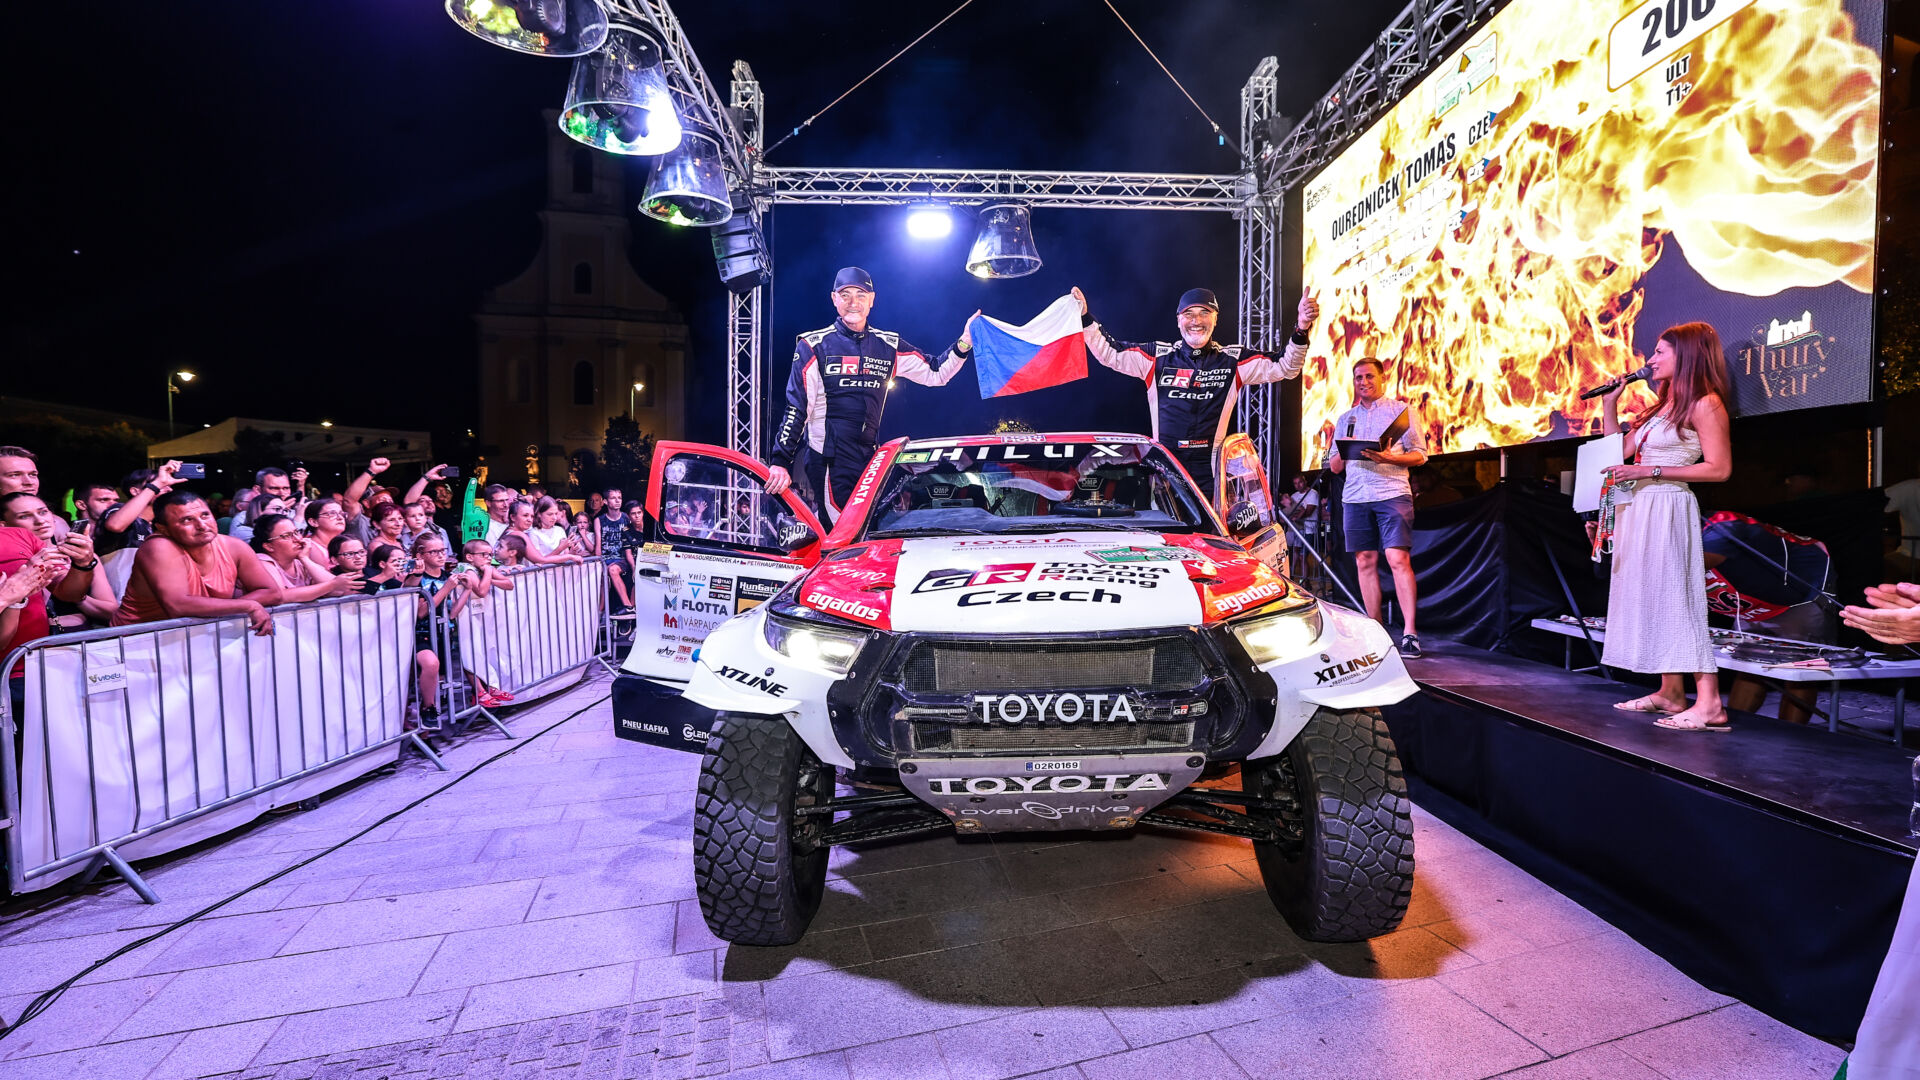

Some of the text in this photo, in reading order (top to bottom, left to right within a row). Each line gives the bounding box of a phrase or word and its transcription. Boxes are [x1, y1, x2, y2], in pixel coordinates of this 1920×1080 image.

[1666, 55, 1690, 83] ULT
[1666, 83, 1691, 106] T1+
[1332, 173, 1400, 241] OUREDNICEK
[1405, 132, 1456, 189] TOMAS
[1468, 115, 1489, 146] CZE
[825, 363, 859, 375] GR
[863, 356, 892, 366] TOYOTA
[862, 368, 888, 379] Racing
[1197, 368, 1231, 376] TOYOTA
[839, 378, 881, 389] Czech
[1160, 375, 1190, 388] GR
[1168, 389, 1214, 400] Czech
[779, 405, 797, 446] HILUX
[929, 444, 1124, 462] HILUX
[852, 450, 888, 506] MUSICDATA
[1081, 478, 1098, 486] OMP
[779, 522, 808, 543] SHOT
[954, 538, 1077, 546] TOYOTA
[1041, 568, 1160, 579] GAZOO
[1045, 562, 1171, 574] TOYOTA
[913, 567, 1035, 593] GR
[1037, 574, 1158, 589] Racing
[957, 588, 1122, 607] Czech
[1213, 582, 1281, 612] agados
[681, 599, 729, 616] FLOTTA
[806, 591, 883, 621] agados
[683, 617, 720, 631] VÁRPALO
[1313, 652, 1383, 685] XTLINE
[714, 665, 789, 698] XTLINE
[1331, 673, 1361, 686] PROFESSIONAL
[974, 693, 1137, 723] TOYOTA
[622, 719, 670, 735] PNEU KAFKA
[1033, 761, 1079, 770] 02R0169
[928, 773, 1168, 796] TOYOTA
